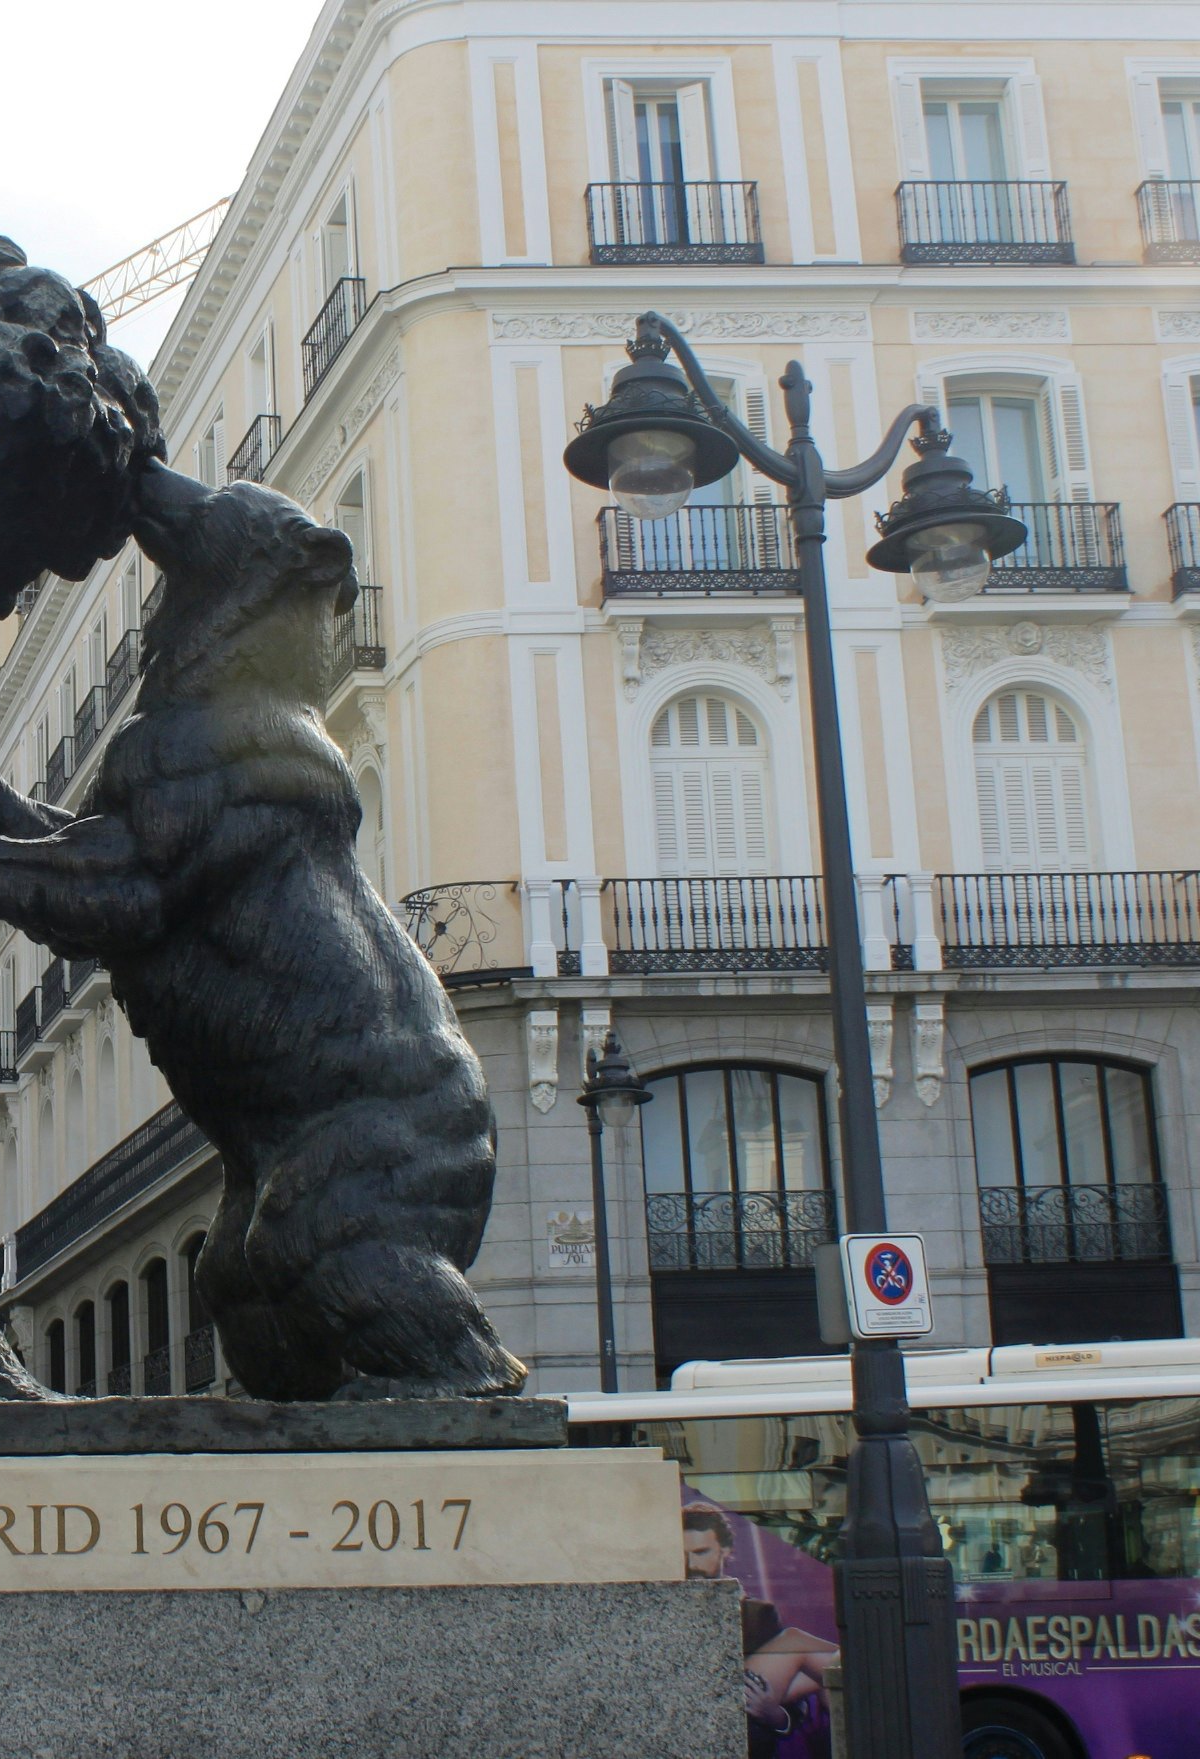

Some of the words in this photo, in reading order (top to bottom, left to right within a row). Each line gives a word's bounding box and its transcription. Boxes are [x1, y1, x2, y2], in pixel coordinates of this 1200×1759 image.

[129, 1501, 265, 1555] 1967
[331, 1498, 472, 1552] 2017
[1002, 1663, 1018, 1676] EL
[1021, 1661, 1084, 1676] MUSICAL
